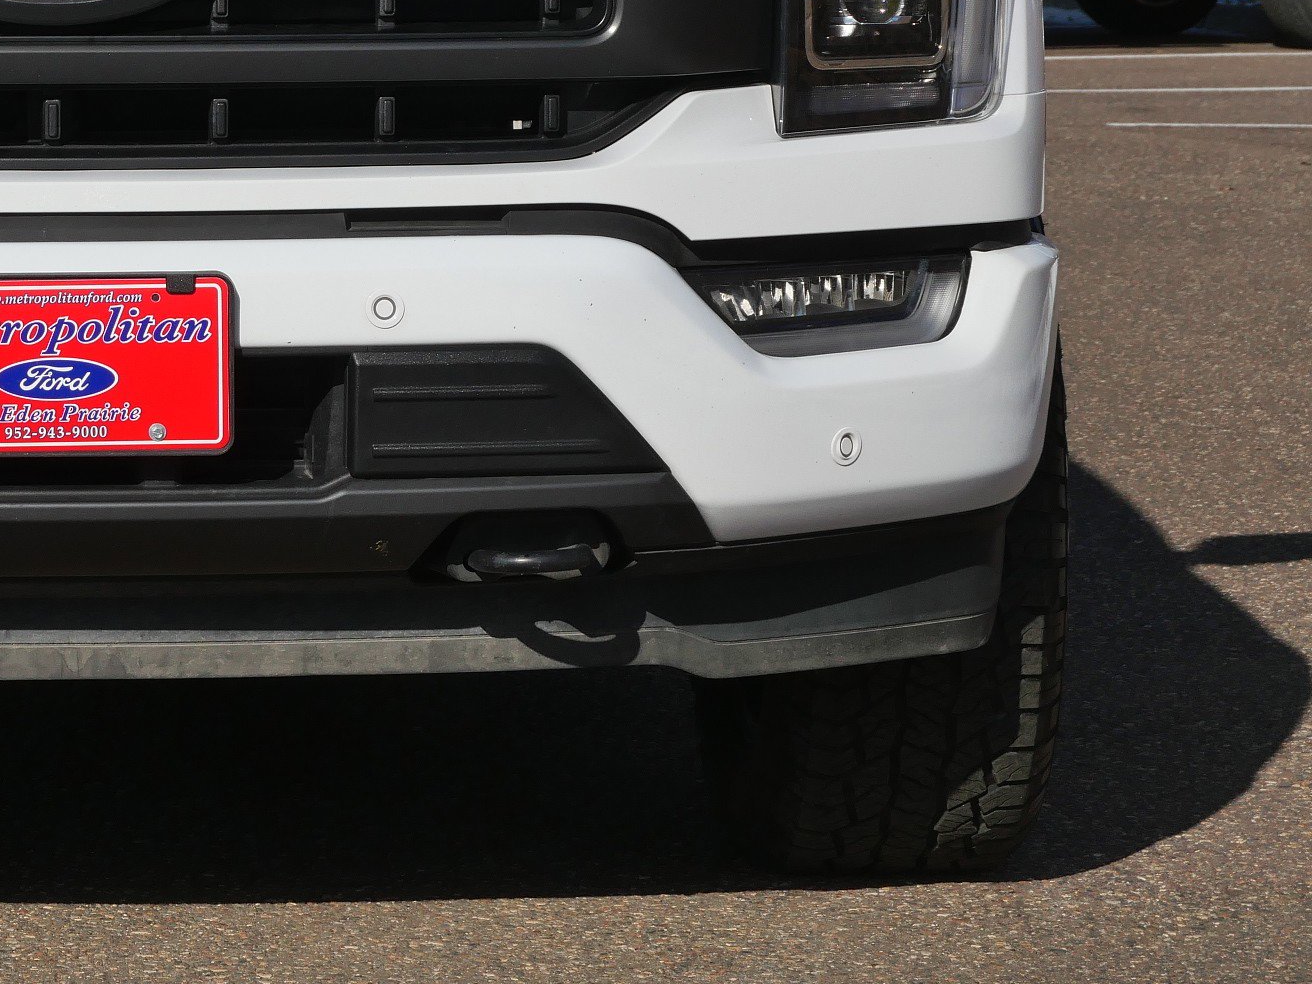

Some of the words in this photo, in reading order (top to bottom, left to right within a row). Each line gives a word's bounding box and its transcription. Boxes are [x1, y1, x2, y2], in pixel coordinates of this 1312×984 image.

[19, 365, 91, 392] Ford
[0, 403, 56, 423] Eden
[59, 402, 141, 422] Prairie
[4, 425, 108, 440] 952-943-9000
